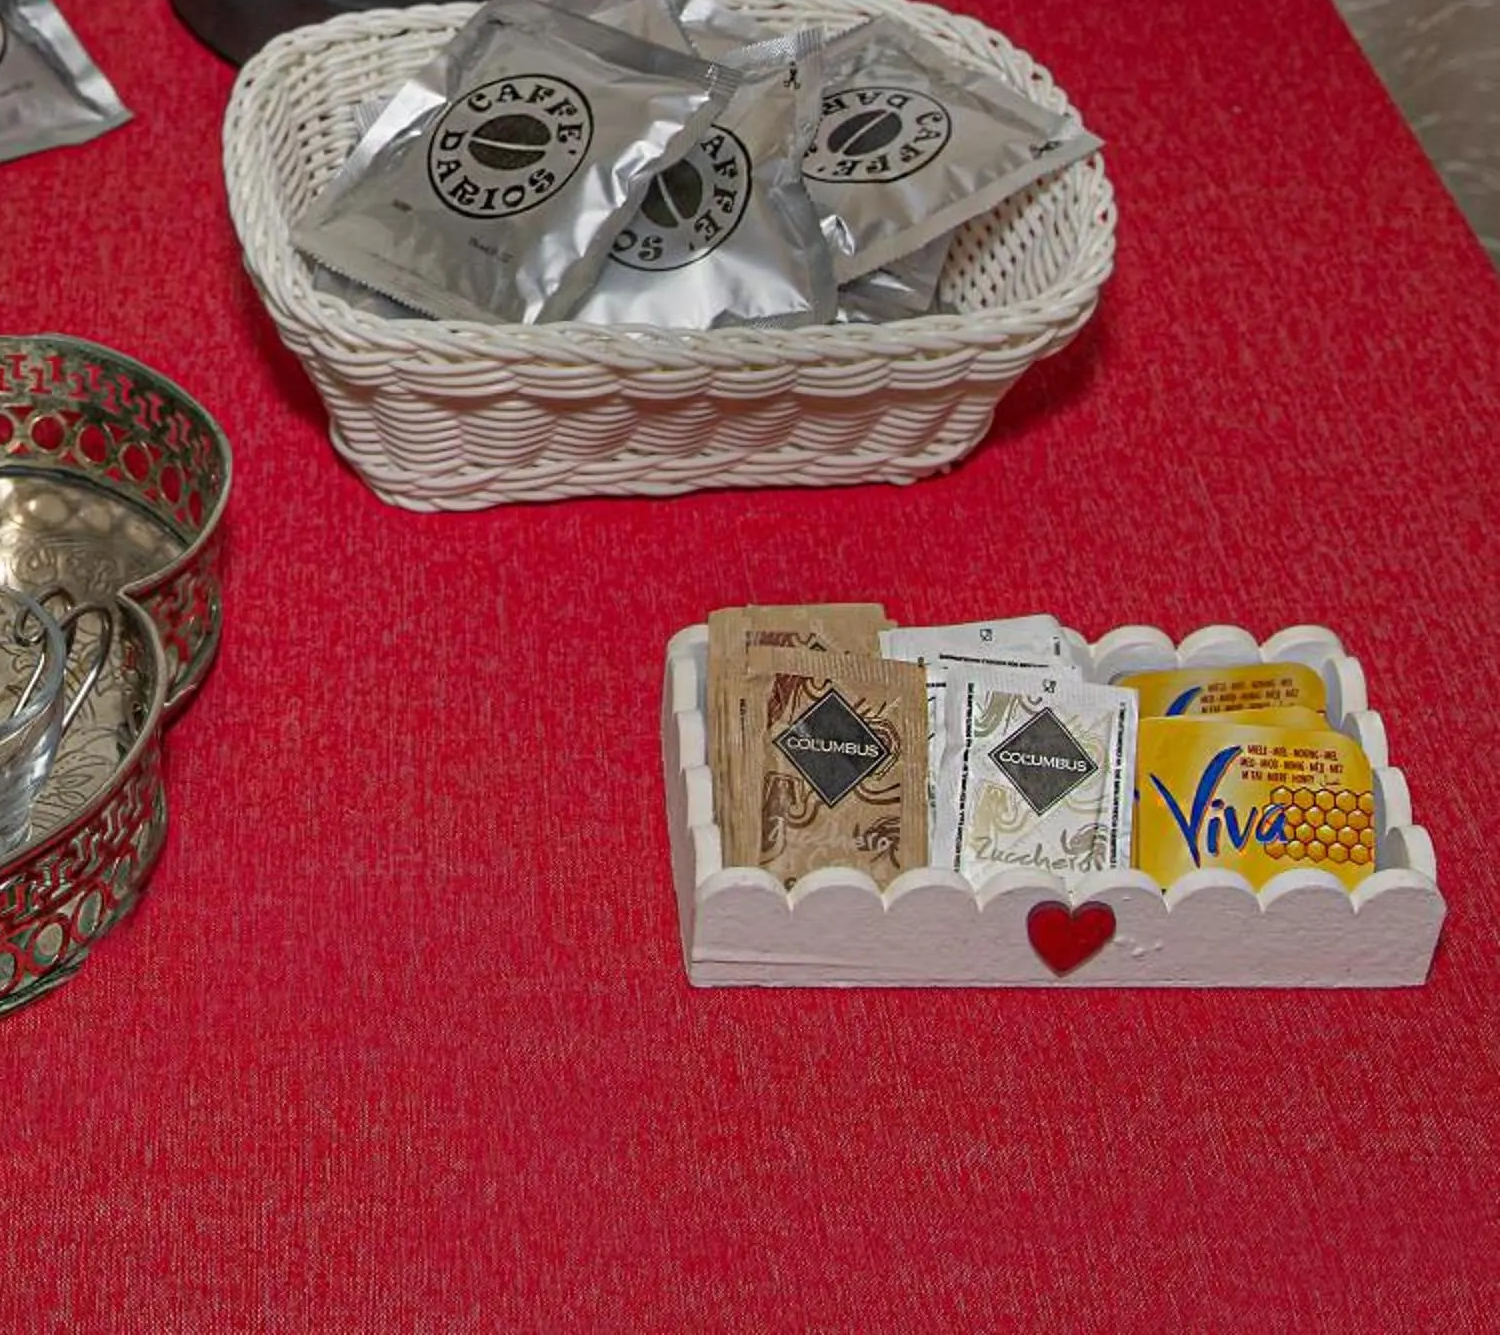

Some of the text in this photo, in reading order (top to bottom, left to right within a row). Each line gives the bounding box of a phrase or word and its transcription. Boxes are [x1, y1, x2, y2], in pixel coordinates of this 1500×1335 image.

[436, 129, 556, 210] DARIOS
[786, 735, 880, 758] COLUMBUS
[999, 750, 1088, 773] COLUMBUS
[1150, 745, 1288, 869] Viva
